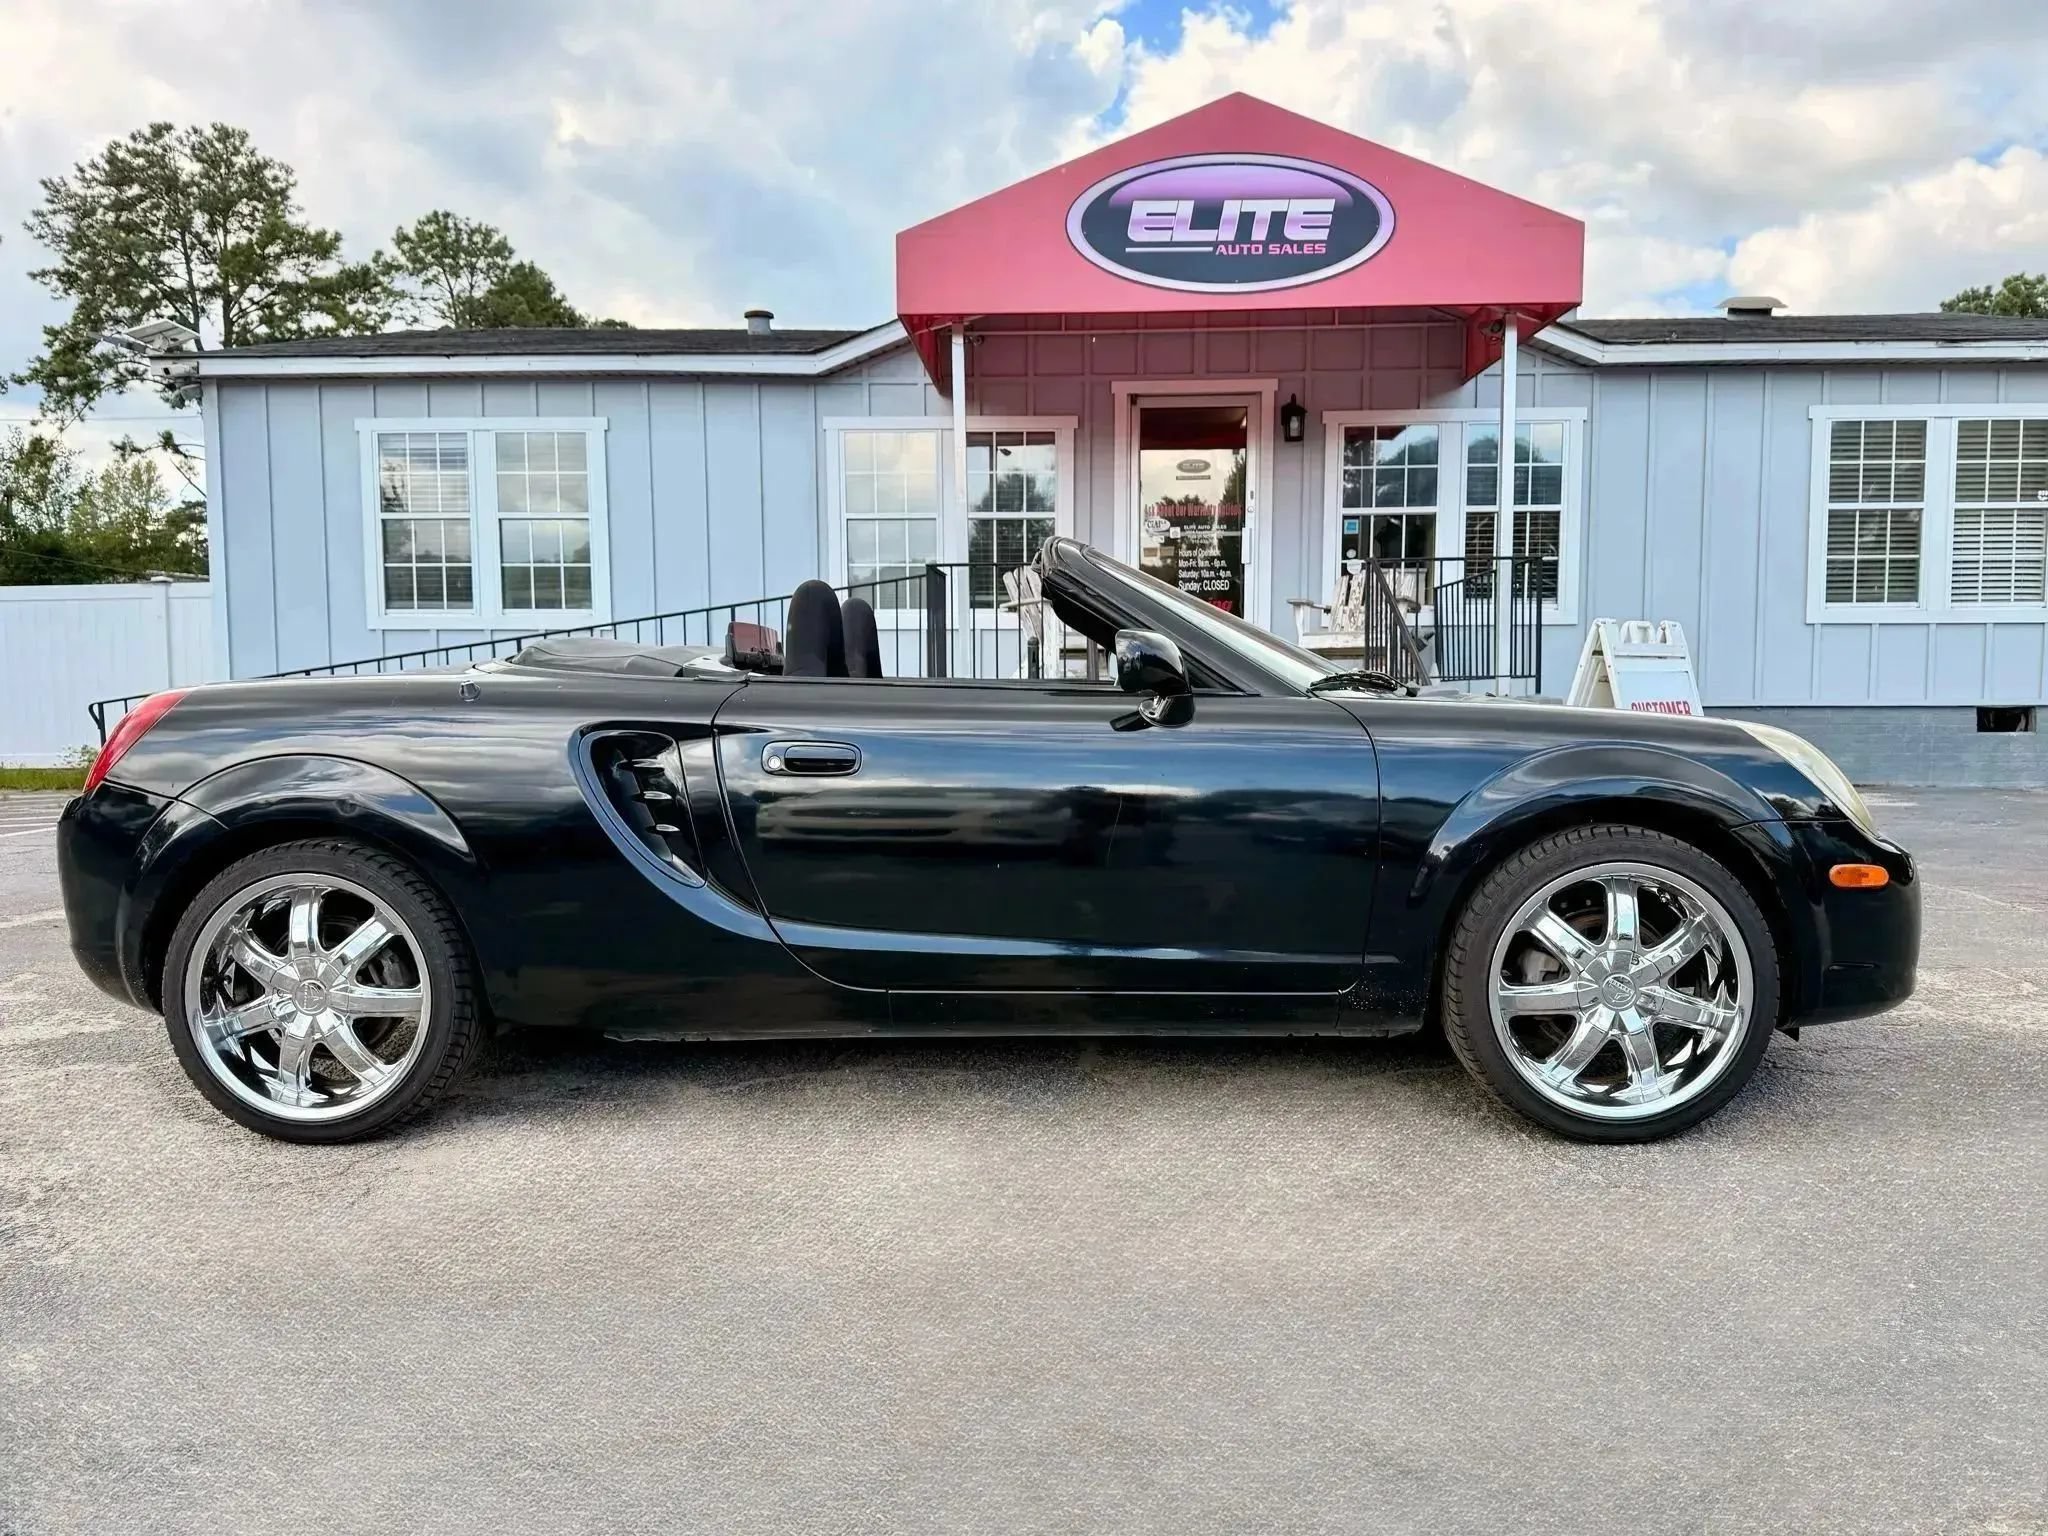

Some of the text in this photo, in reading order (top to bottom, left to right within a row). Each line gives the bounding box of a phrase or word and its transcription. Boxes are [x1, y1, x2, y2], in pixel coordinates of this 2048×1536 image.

[1127, 199, 1336, 242] ELITE
[1215, 243, 1326, 255] AUTO SALES
[1202, 580, 1230, 591] CLOSED
